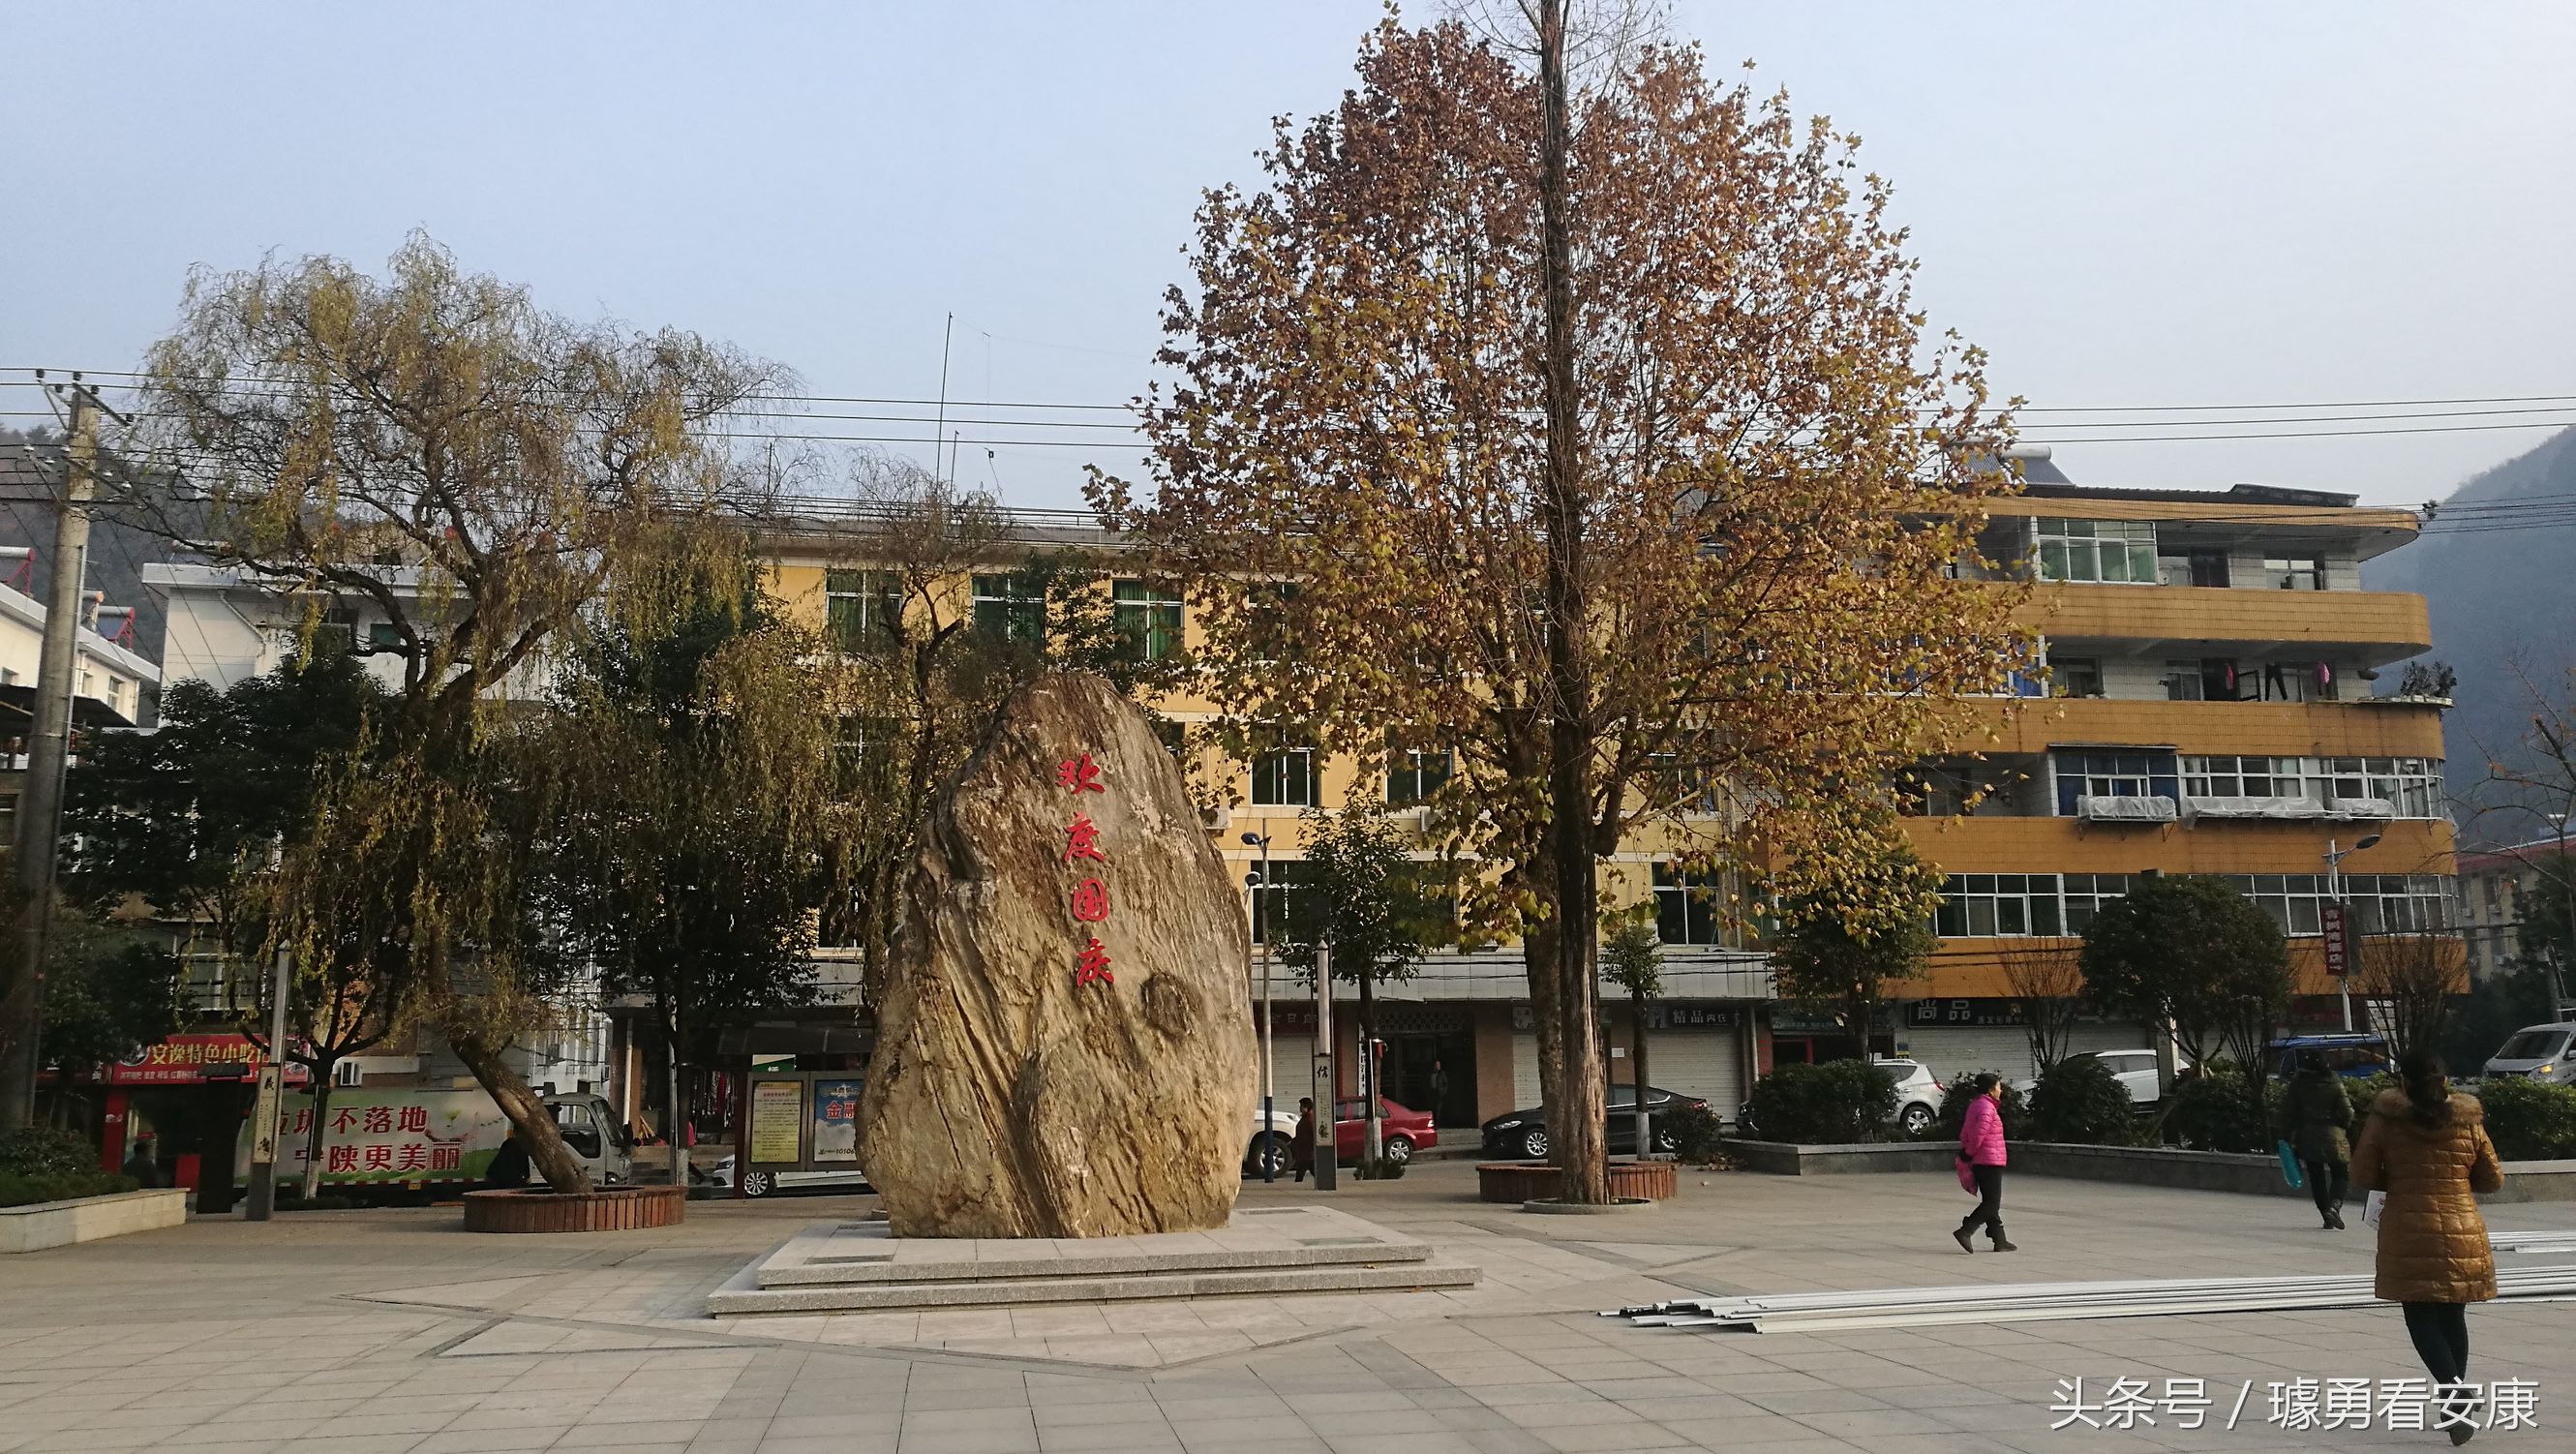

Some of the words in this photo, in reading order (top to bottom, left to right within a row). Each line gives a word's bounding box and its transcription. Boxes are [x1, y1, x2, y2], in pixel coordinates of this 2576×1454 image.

[1055, 753, 1115, 987] 欢度国庆
[1918, 999, 1971, 1020] 尚品
